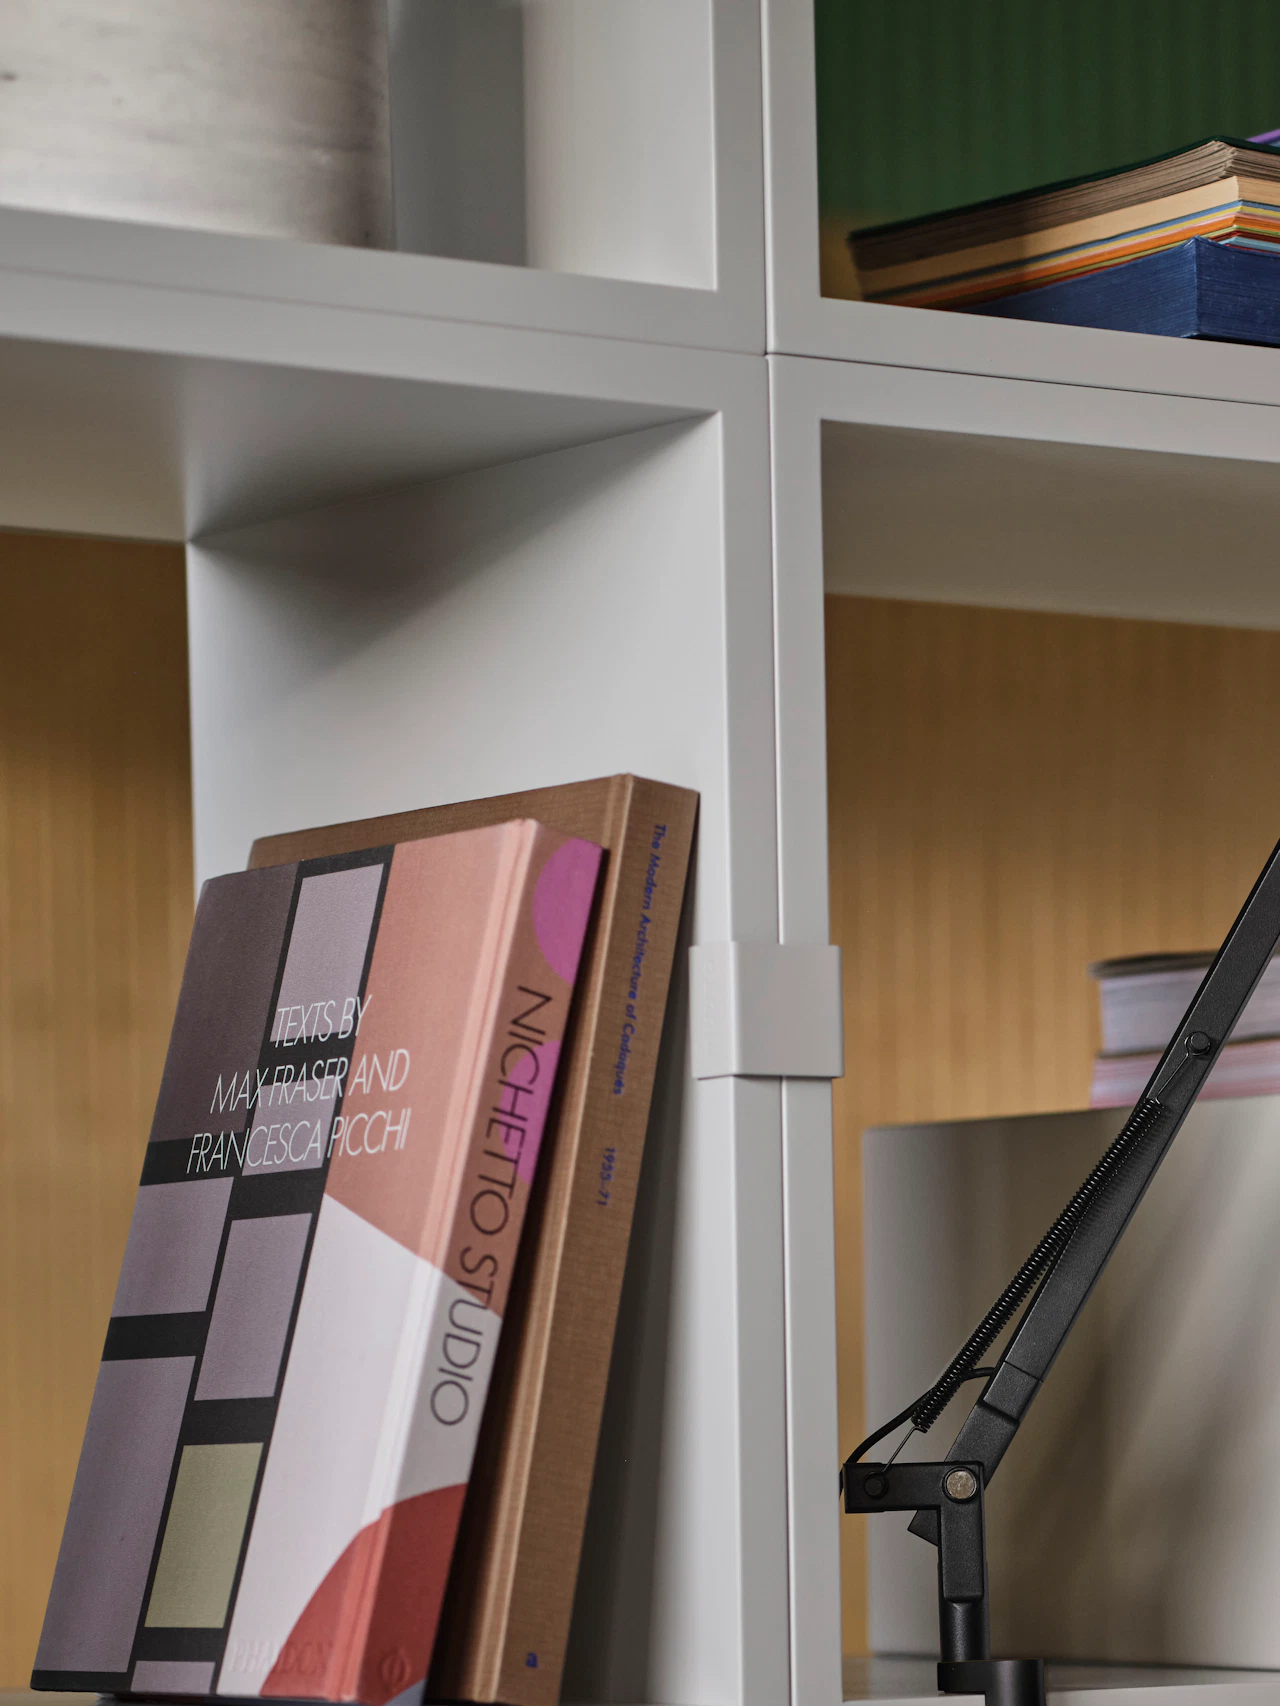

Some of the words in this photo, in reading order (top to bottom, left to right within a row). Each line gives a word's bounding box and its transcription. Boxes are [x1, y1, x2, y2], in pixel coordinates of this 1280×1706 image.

[652, 824, 667, 849] The
[642, 853, 661, 910] Modern
[628, 914, 652, 999] Architecture
[275, 1000, 335, 1048] TEXTS
[338, 994, 372, 1039] BY
[625, 1004, 638, 1020] of
[210, 1067, 269, 1114] MAX
[268, 1057, 349, 1106] FRASER
[348, 1049, 411, 1096] AND
[469, 985, 553, 1235] NICHETTO
[186, 1118, 322, 1174] FRANCESCA
[327, 1107, 412, 1159] PICCHI
[430, 1245, 499, 1426] STUDIO
